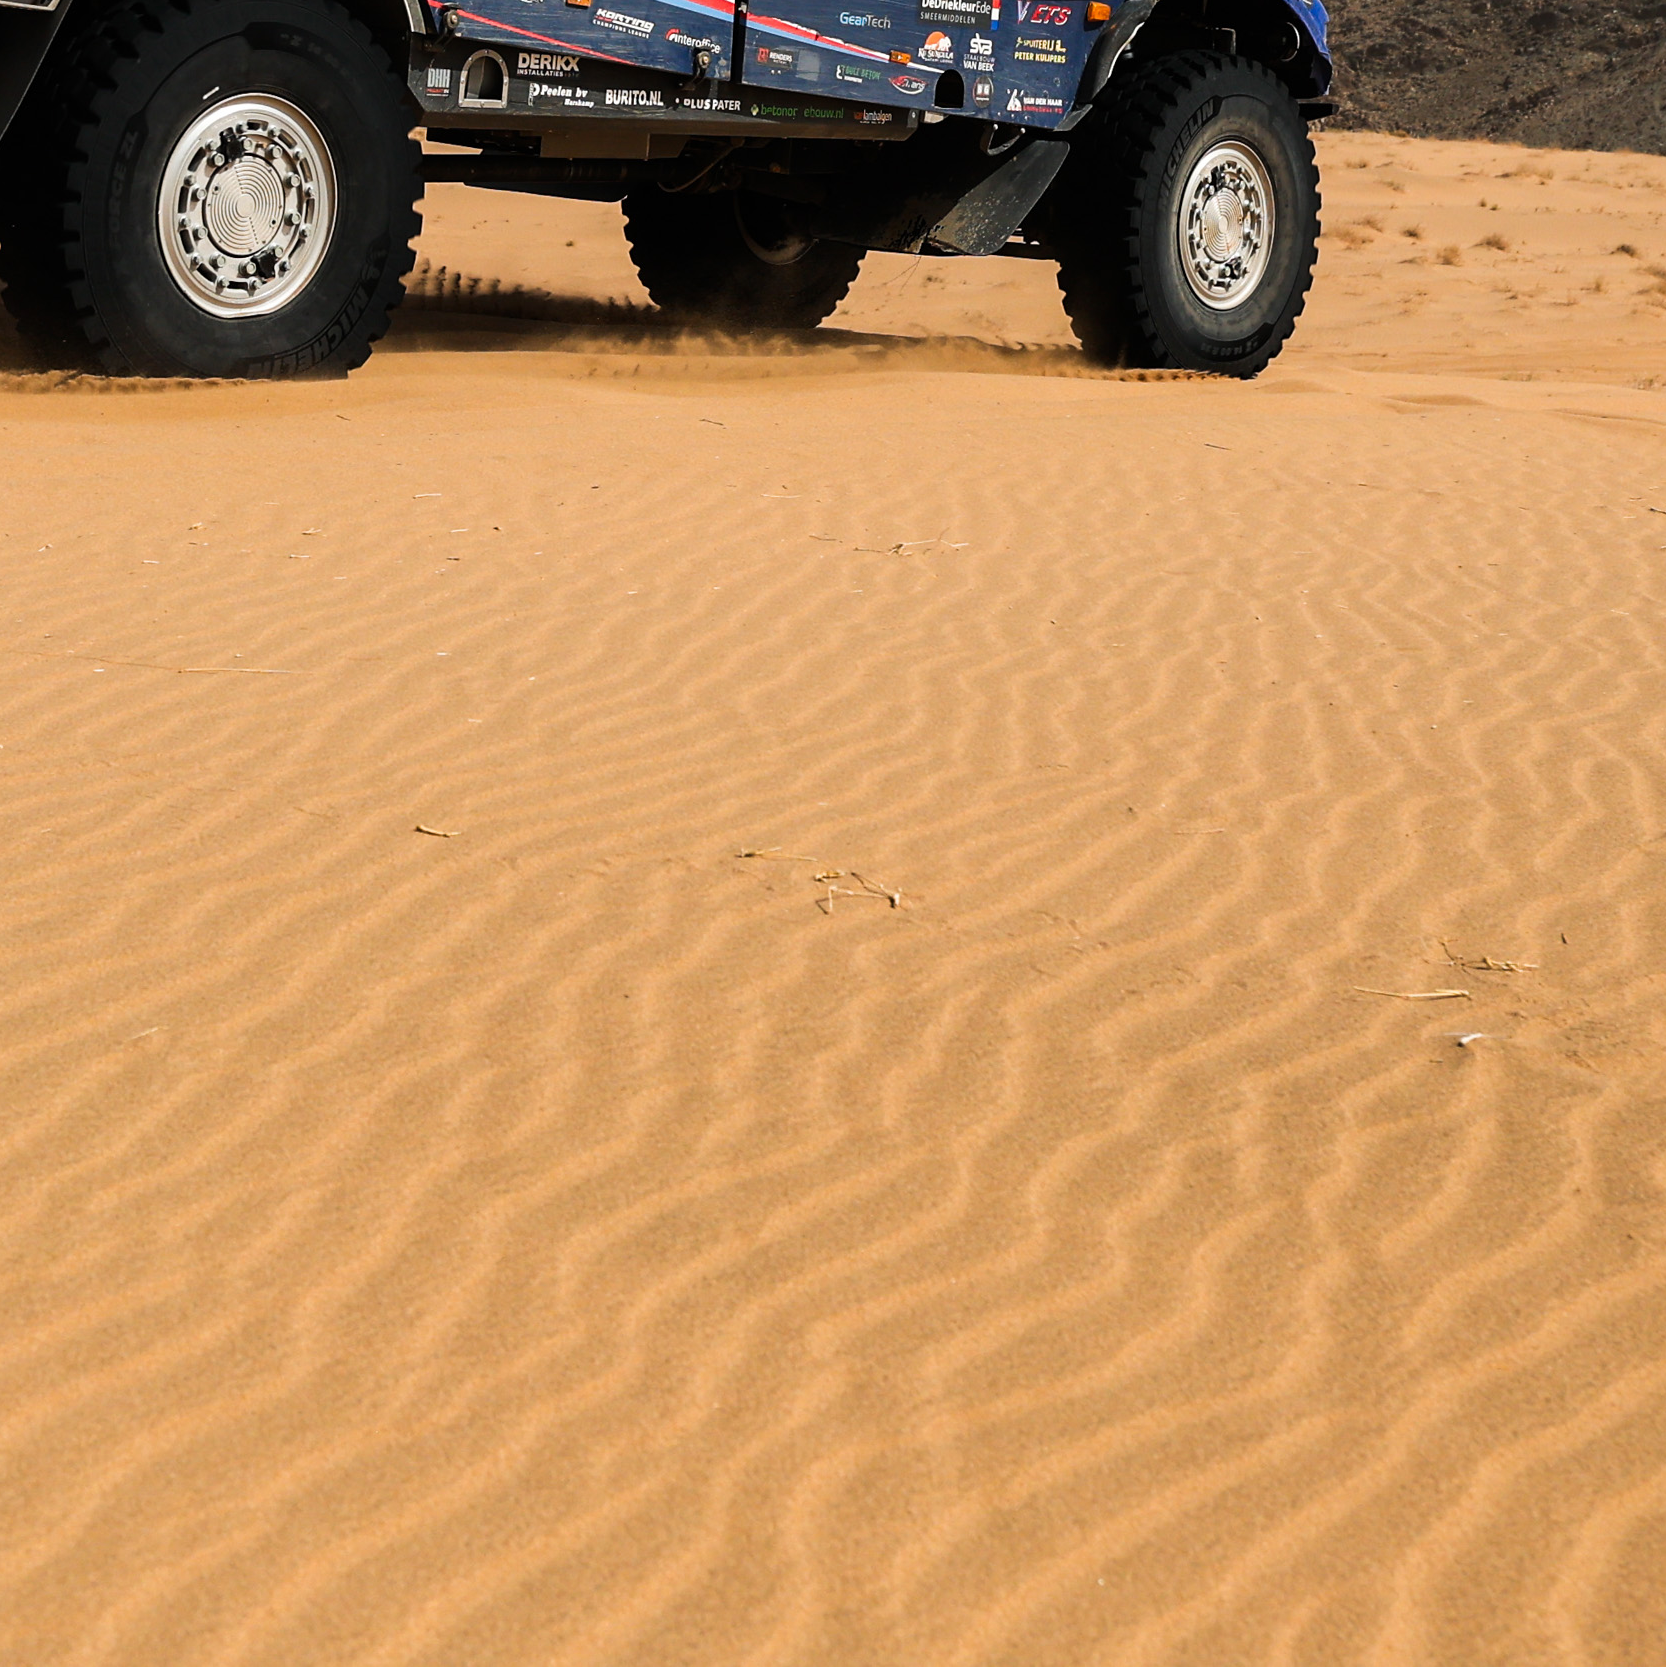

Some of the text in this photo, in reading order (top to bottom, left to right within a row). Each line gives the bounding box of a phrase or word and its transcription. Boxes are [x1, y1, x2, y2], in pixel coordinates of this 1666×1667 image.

[840, 11, 891, 29] GearTech
[920, 11, 976, 24] SMEERMIDDELEN
[593, 19, 649, 39] CHAMPIONS LEAGUE
[518, 53, 579, 72] DERIKX
[963, 54, 995, 63] STAALBOUW
[1014, 51, 1034, 61] PETER
[963, 59, 977, 70] VAN
[977, 61, 994, 72] BEEK
[517, 69, 564, 77] INSTALLATIES
[541, 85, 588, 98] Peelen bv
[605, 89, 664, 106] BURITO.NL
[712, 99, 741, 111] PATER
[1023, 96, 1035, 105] VAN
